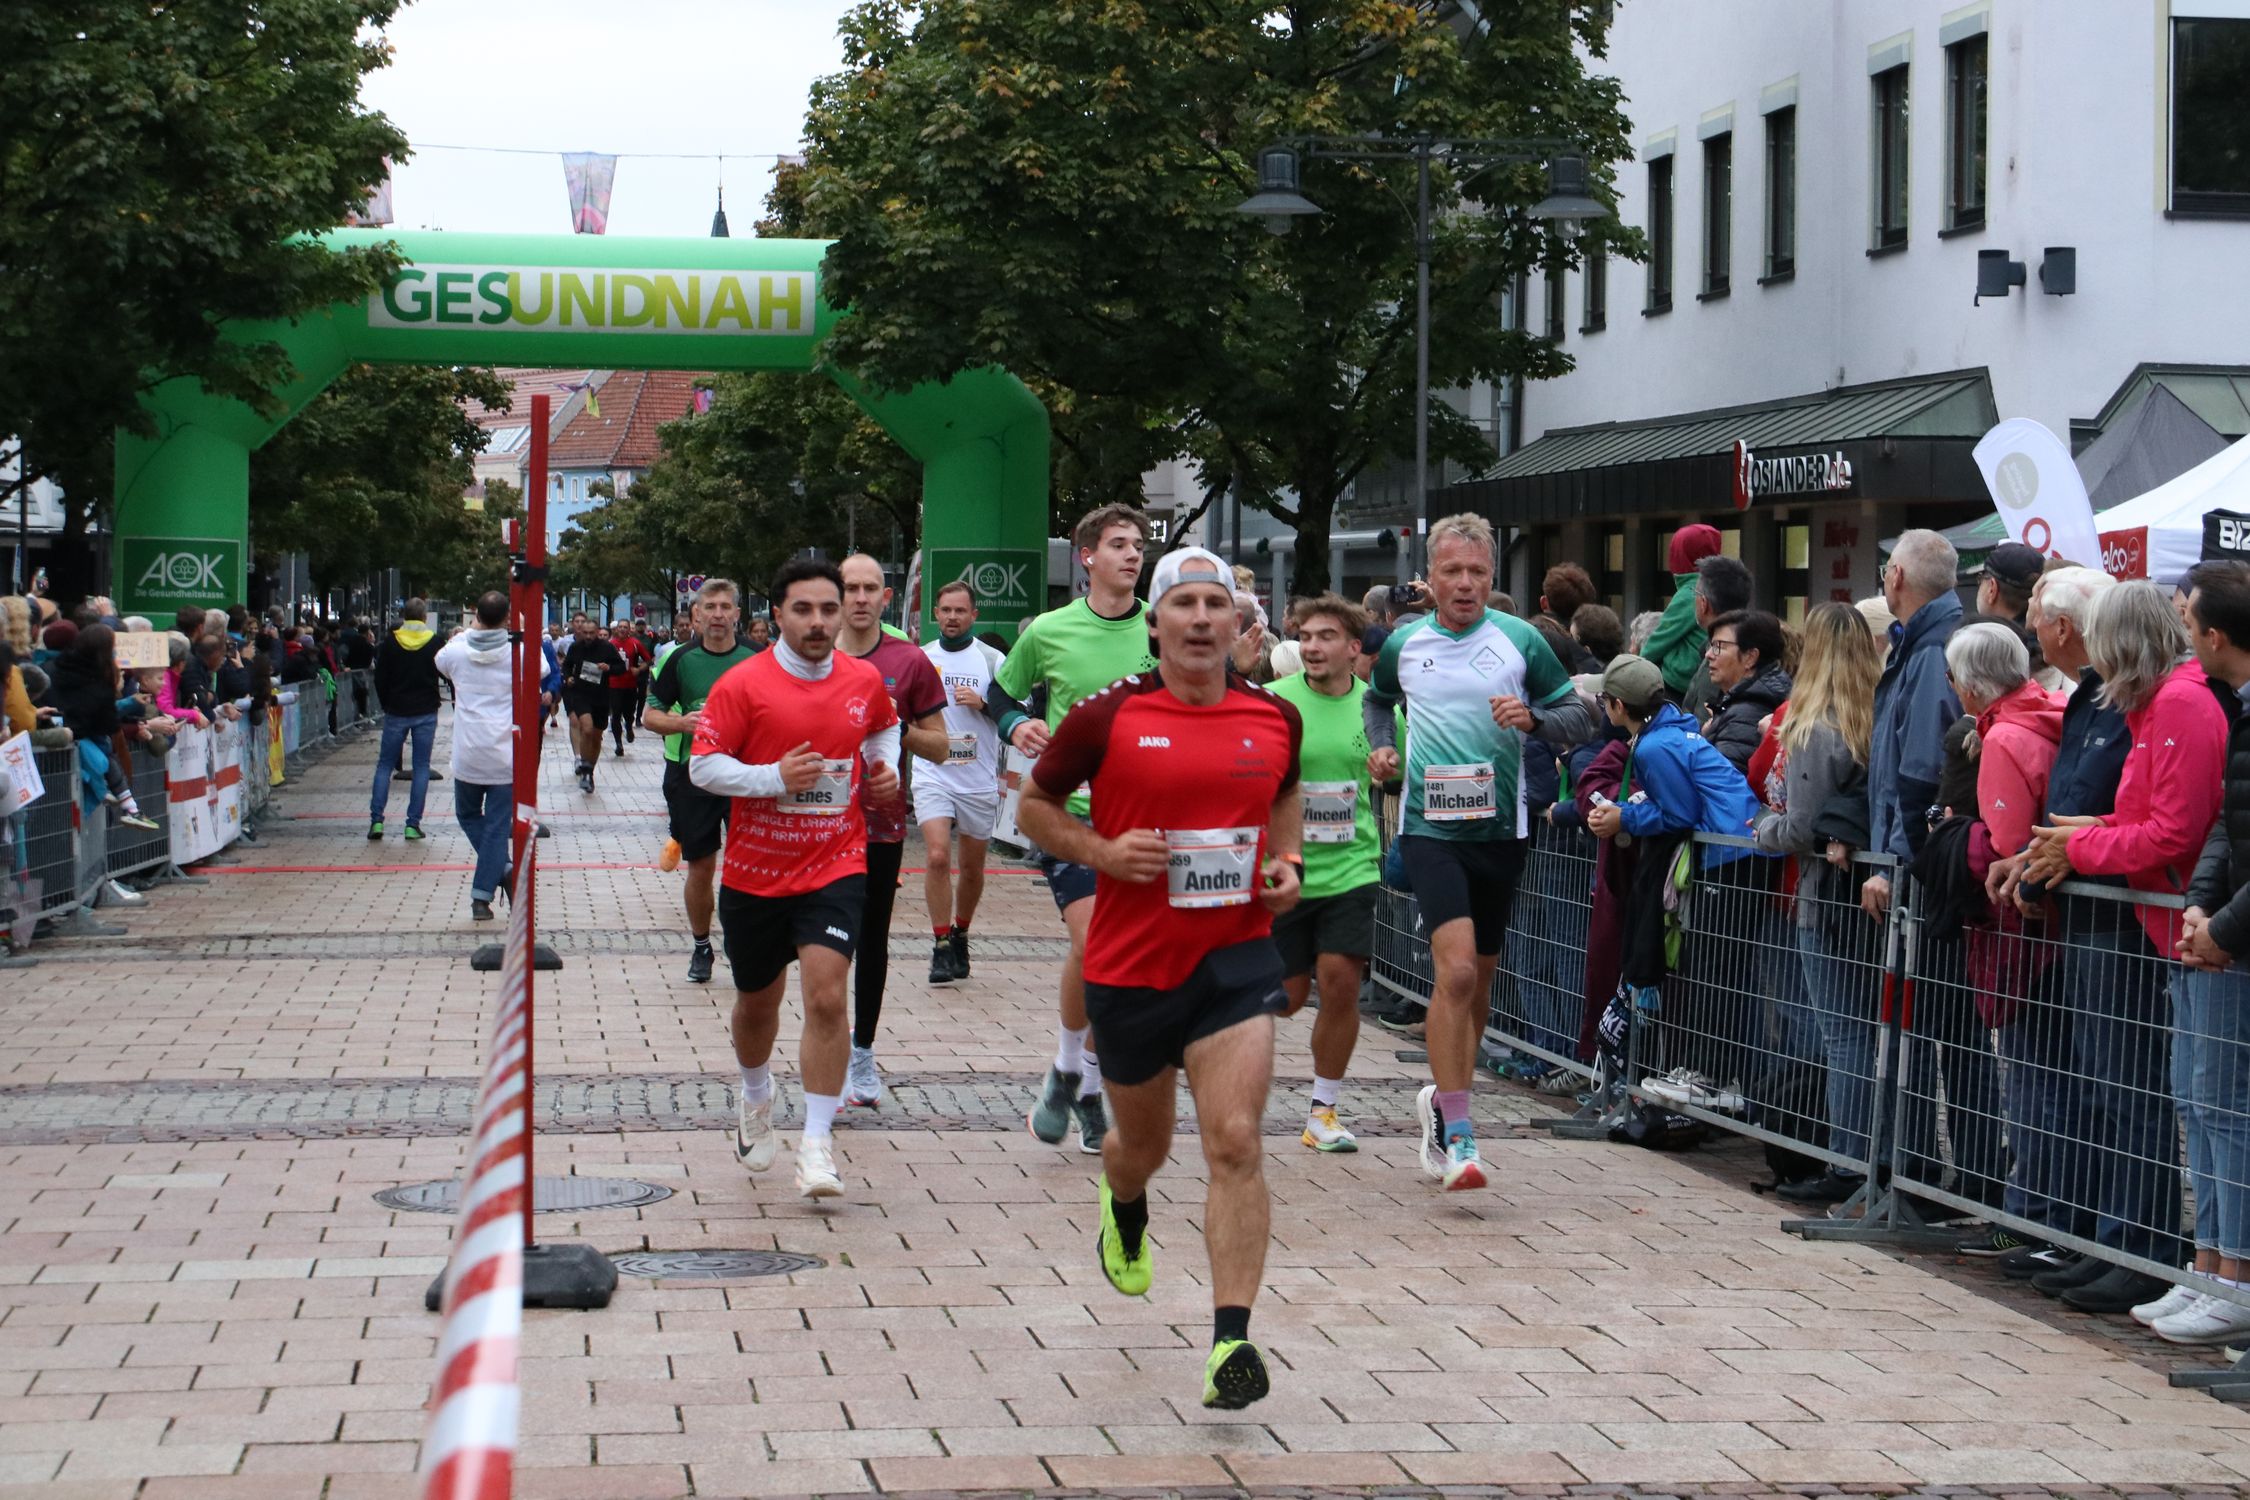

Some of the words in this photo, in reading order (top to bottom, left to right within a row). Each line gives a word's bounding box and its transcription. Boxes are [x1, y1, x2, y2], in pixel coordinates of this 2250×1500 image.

[383, 268, 801, 330] GESUNDNAH
[137, 552, 225, 589] AOK
[955, 562, 1029, 598] AOK
[134, 588, 147, 598] Die
[944, 676, 979, 688] BITZER
[1137, 736, 1171, 748] JAKO
[1426, 782, 1444, 791] 1481
[795, 790, 833, 804] Enes
[1429, 792, 1489, 809] Michael
[771, 830, 811, 842] ARMY
[815, 831, 832, 841] OF
[1184, 870, 1242, 892] Andre
[825, 925, 849, 941] JAKO
